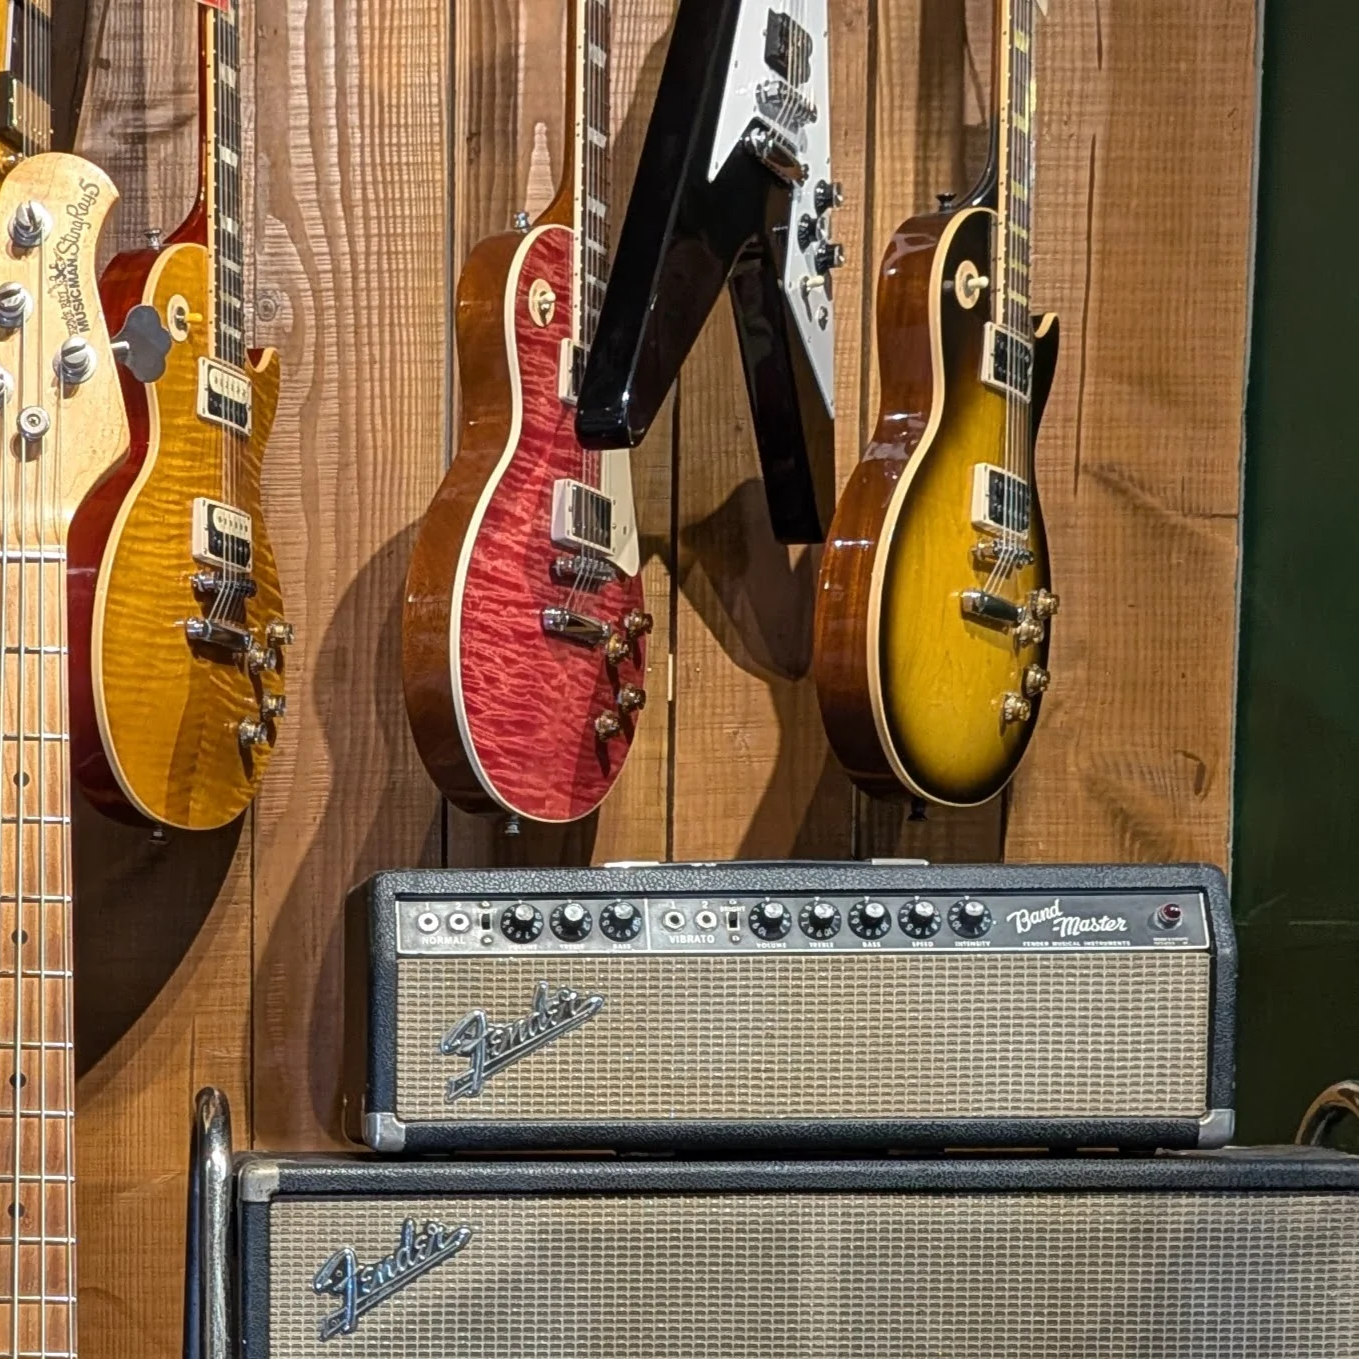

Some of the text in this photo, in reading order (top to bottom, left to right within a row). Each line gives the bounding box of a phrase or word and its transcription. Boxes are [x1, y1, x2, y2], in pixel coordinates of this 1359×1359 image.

[1006, 898, 1064, 934] Band
[421, 936, 466, 945] NORMAL
[669, 935, 716, 944] VIBRATO
[440, 980, 605, 1103] Fender
[312, 1216, 473, 1342] Fender
